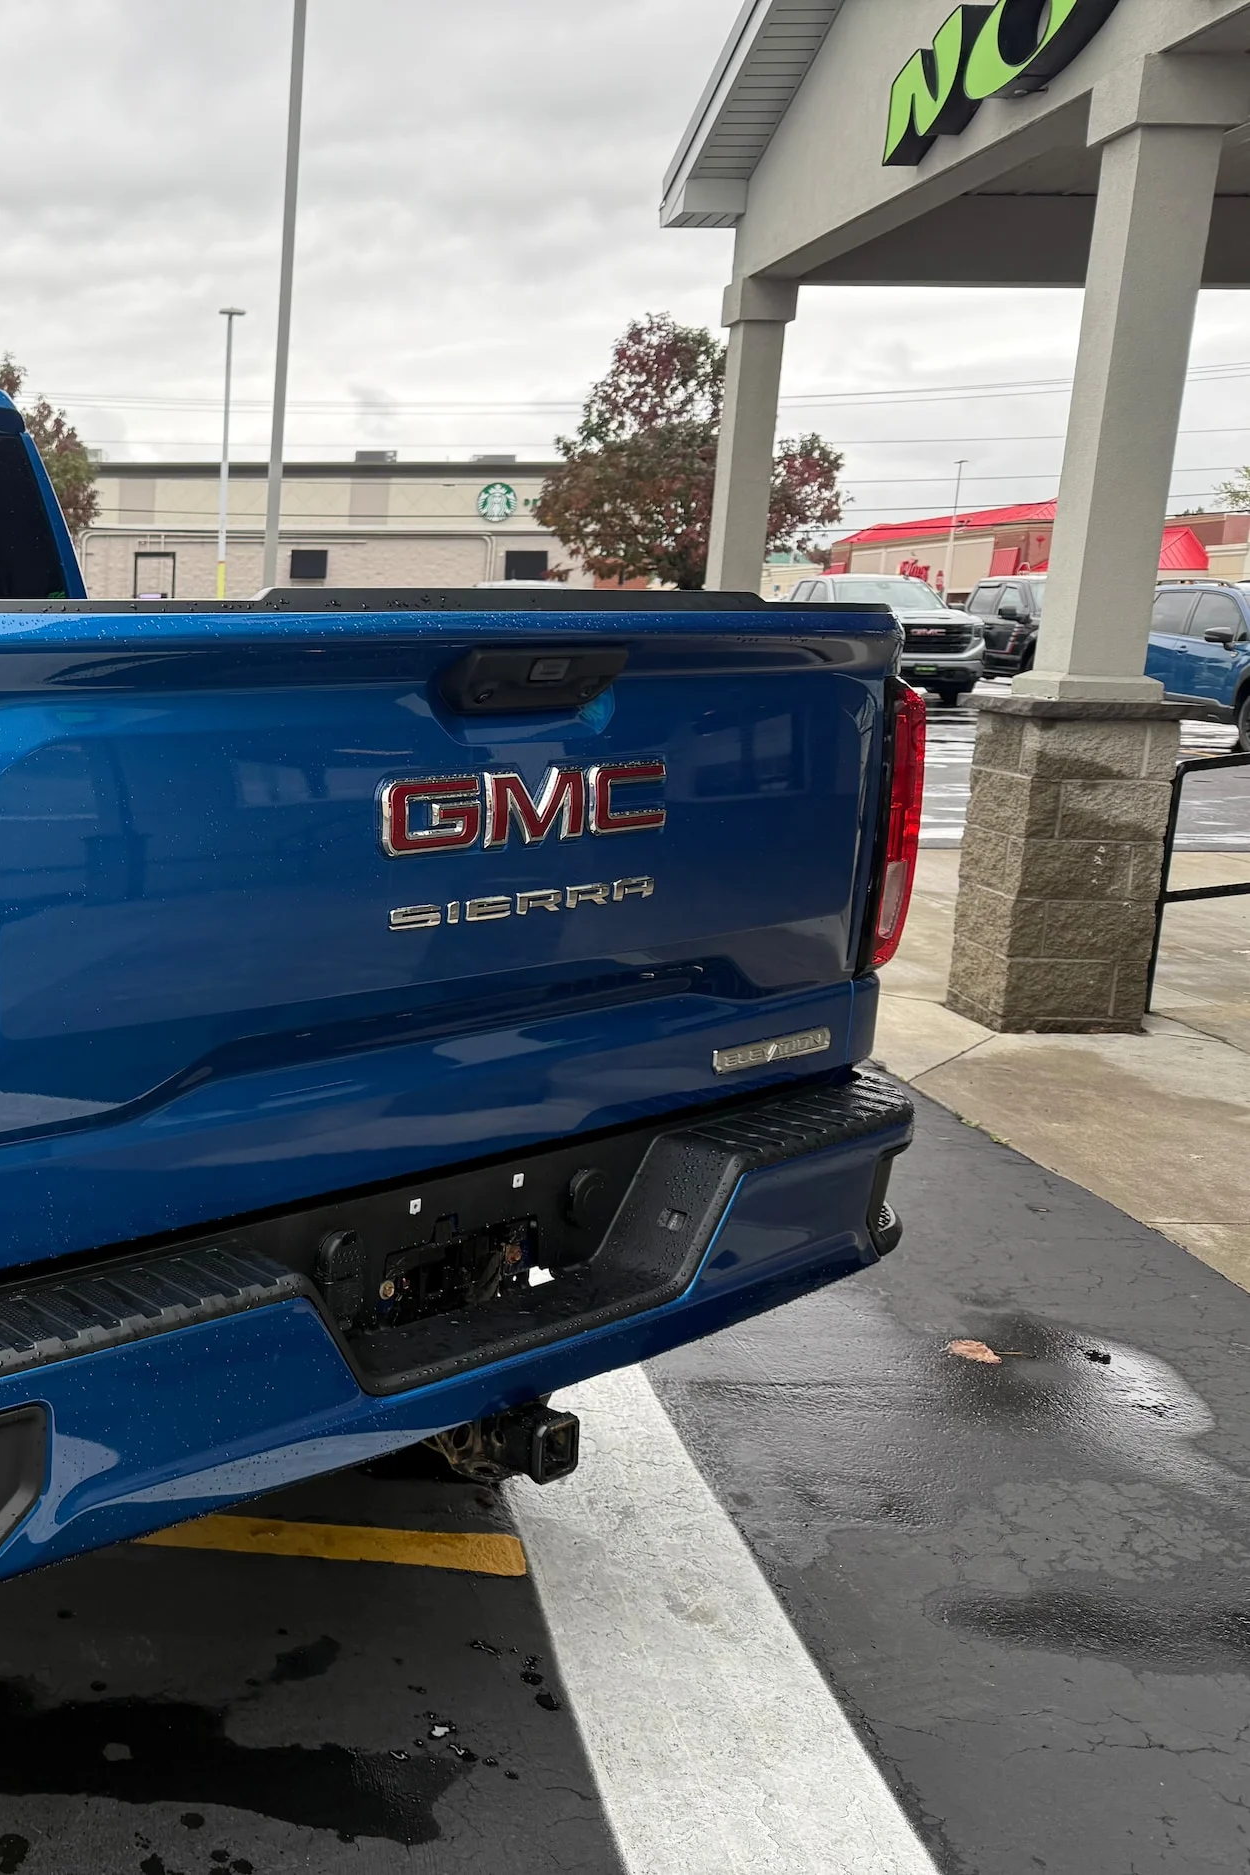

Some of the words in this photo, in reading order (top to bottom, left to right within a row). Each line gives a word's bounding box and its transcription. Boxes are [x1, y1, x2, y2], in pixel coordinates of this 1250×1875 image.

[882, 0, 1085, 166] NO
[910, 628, 947, 636] GMC
[381, 760, 667, 857] GMC
[388, 875, 656, 932] SIERRA
[723, 1032, 823, 1068] ELEVATION
